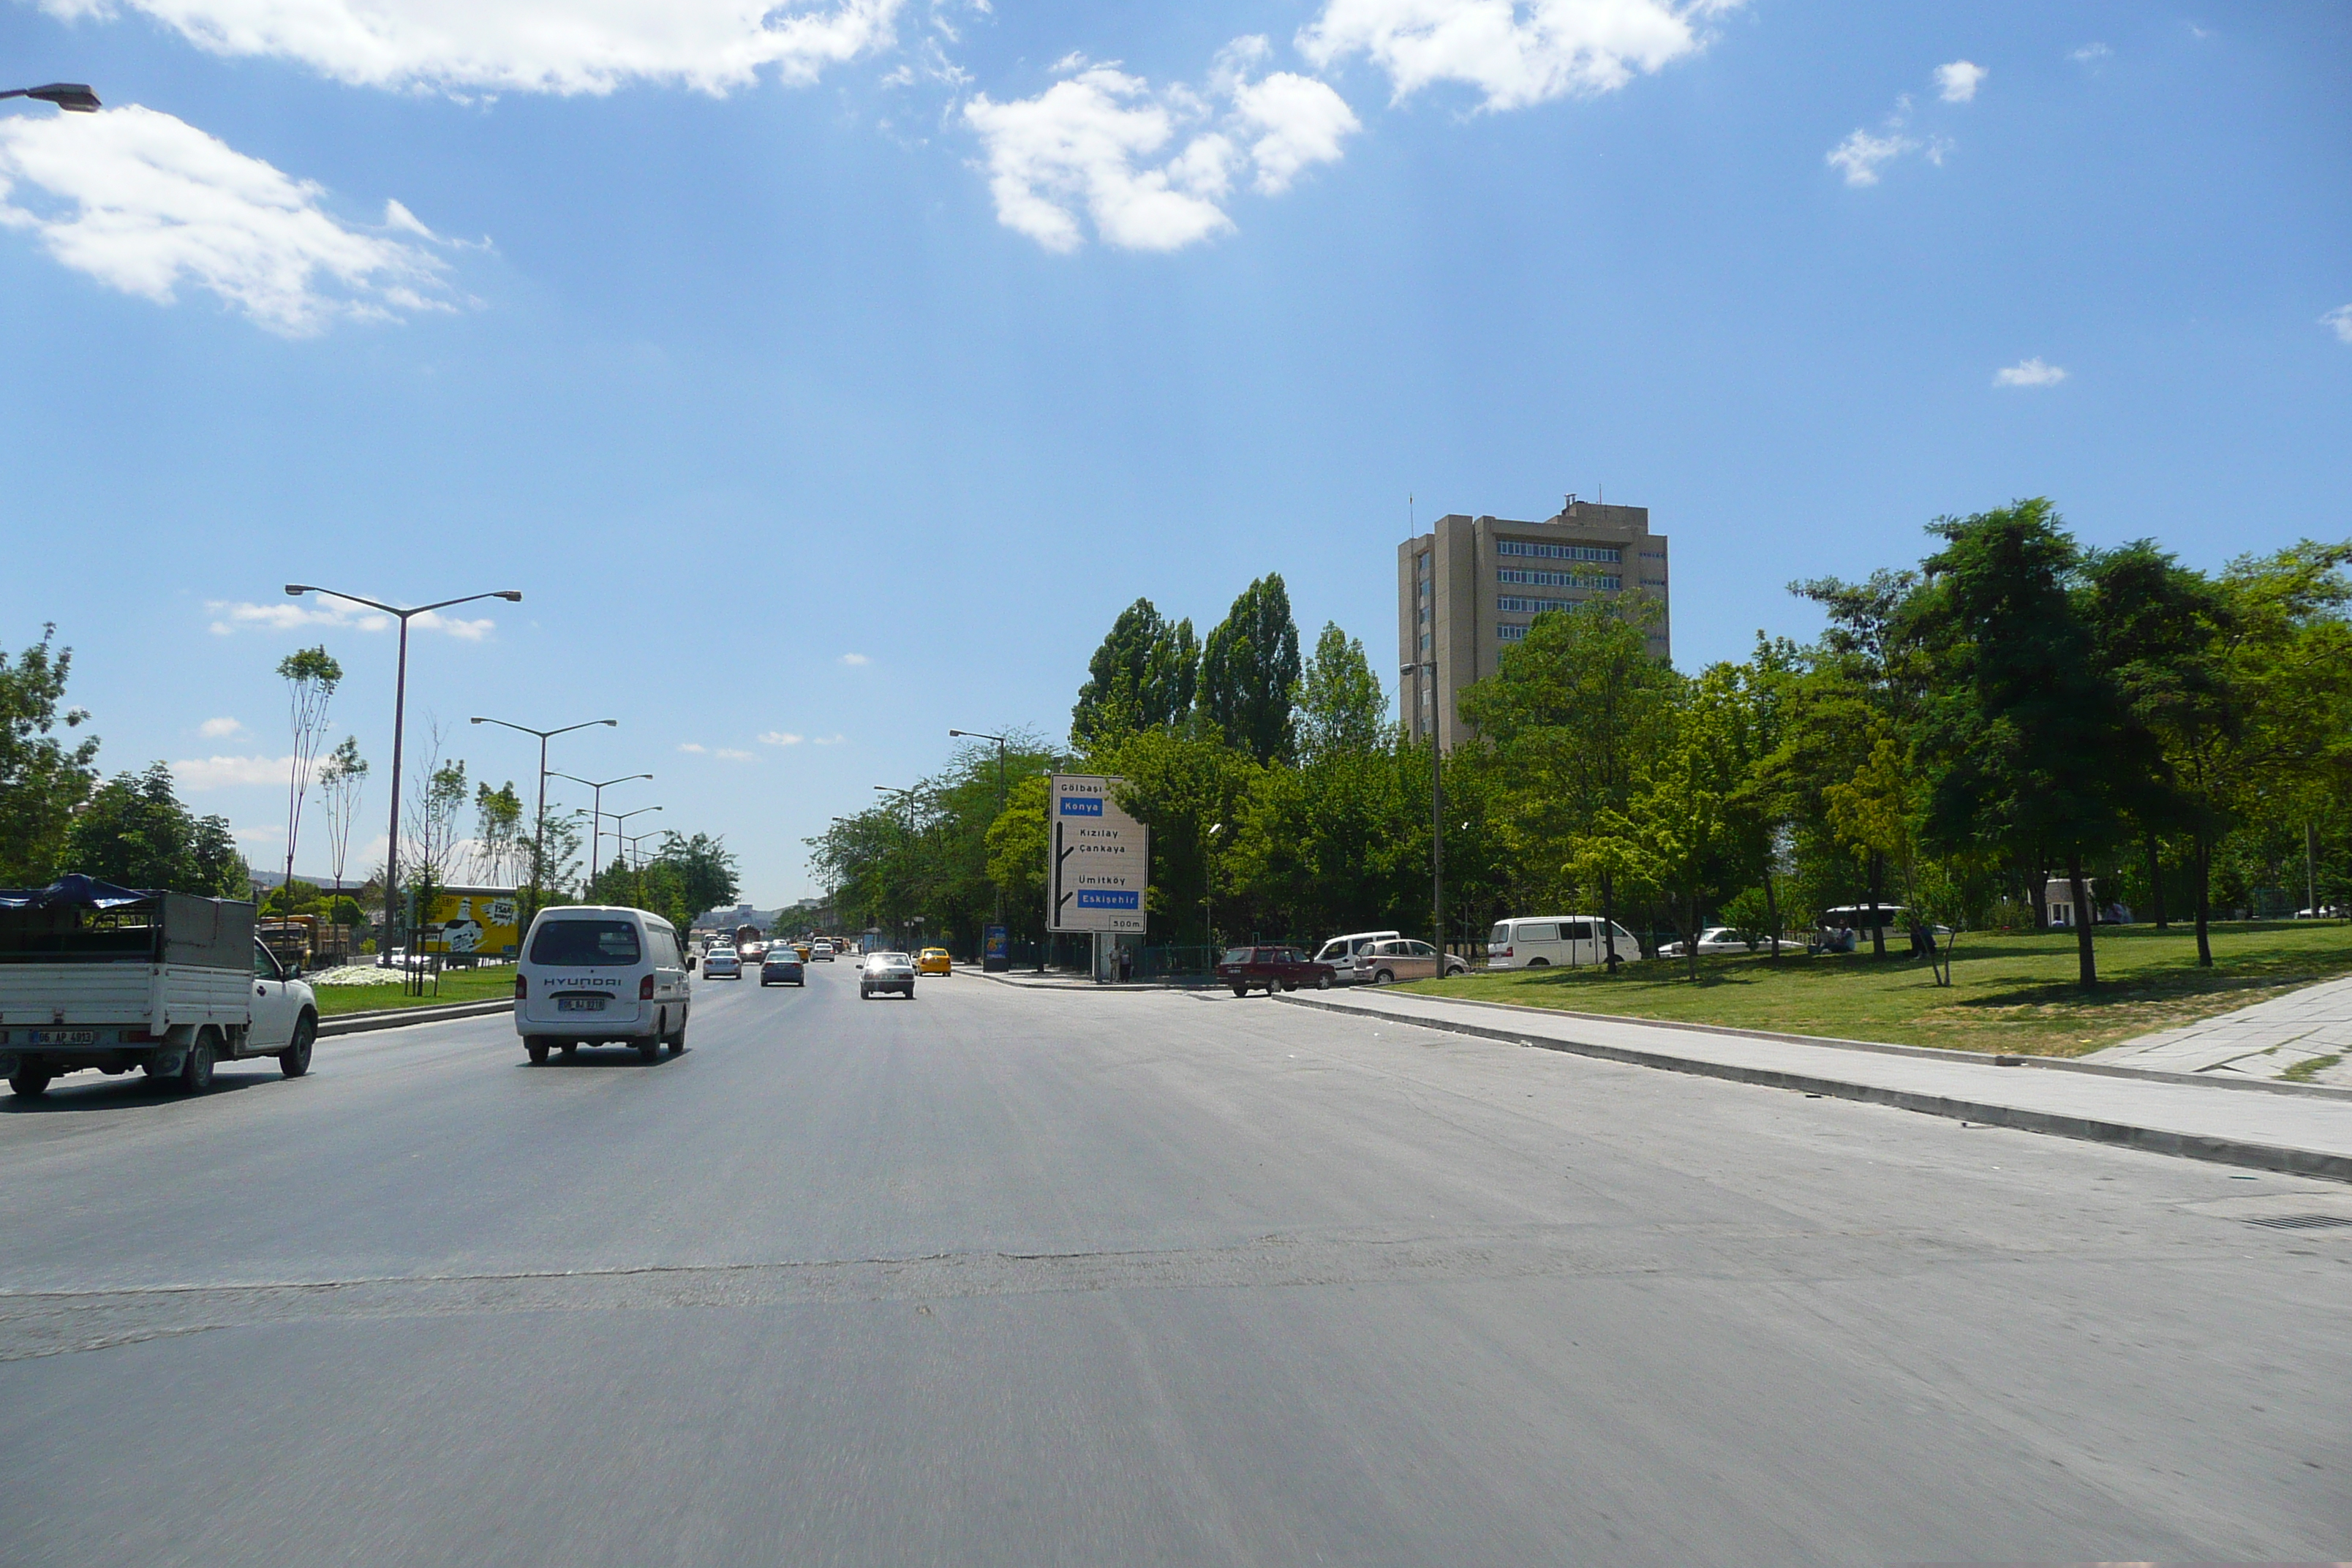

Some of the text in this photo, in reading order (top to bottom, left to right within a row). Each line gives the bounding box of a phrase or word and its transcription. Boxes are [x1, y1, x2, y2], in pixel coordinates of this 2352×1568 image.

[1061, 784, 1101, 793] Gölbaşı
[1065, 802, 1098, 812] Konya
[1080, 829, 1118, 839] Kızılay
[1079, 844, 1125, 854] Çankaya
[1082, 894, 1135, 905] Eskişehir
[39, 1033, 50, 1042] 06
[56, 1033, 67, 1042] AP
